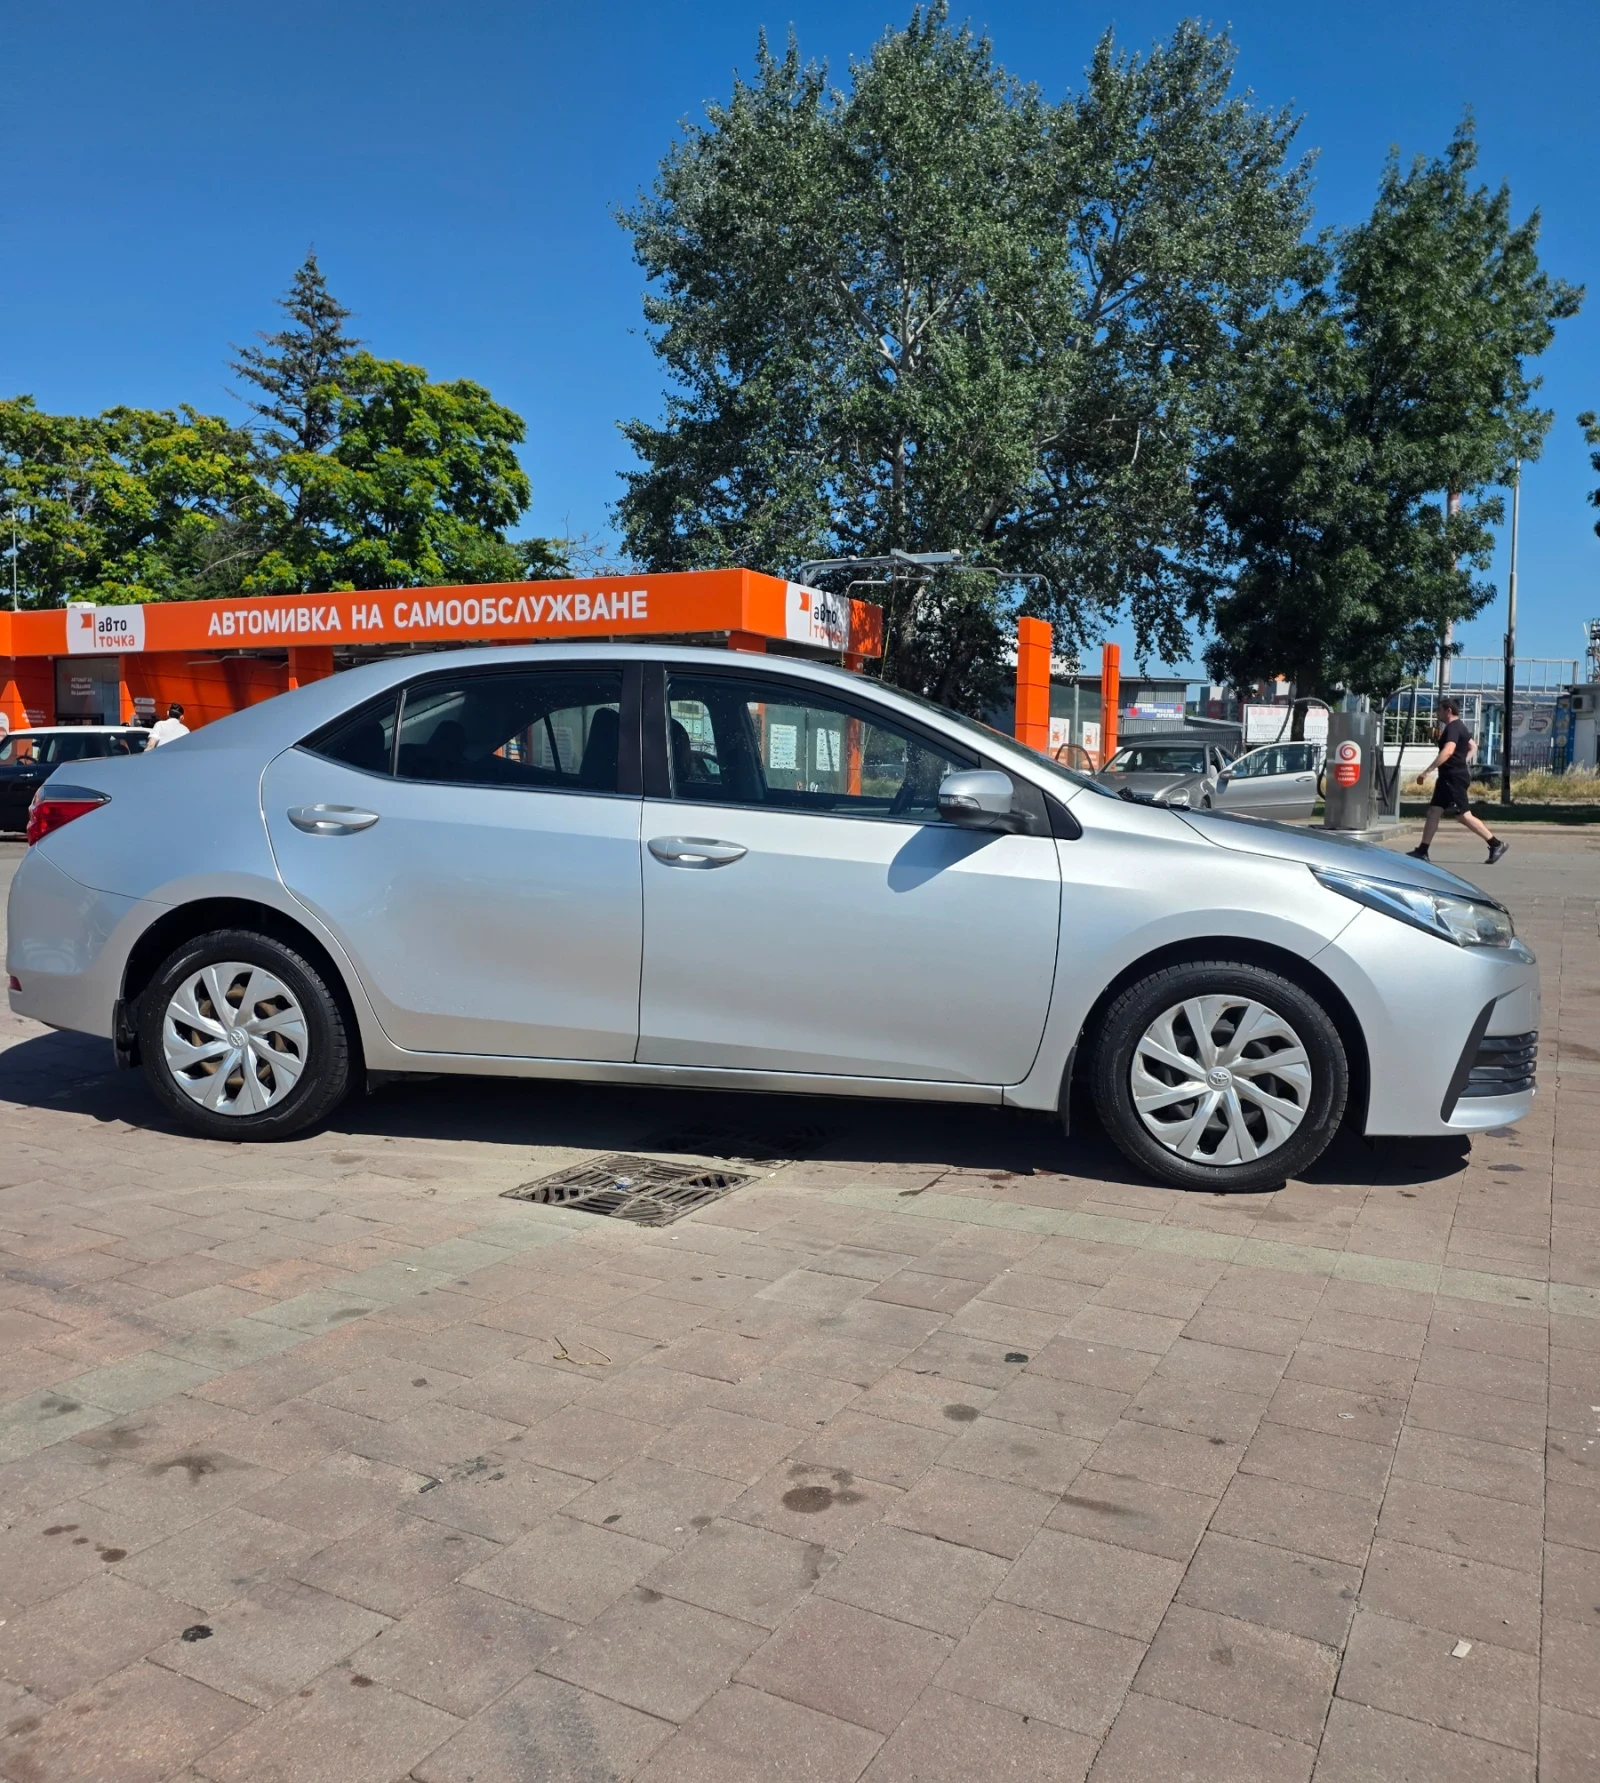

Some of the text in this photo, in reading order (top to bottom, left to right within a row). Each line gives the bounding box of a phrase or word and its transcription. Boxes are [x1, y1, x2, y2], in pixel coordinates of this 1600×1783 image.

[208, 590, 648, 636] АВТОМИВКА НА САМООБСЛУЖВАНЕ
[98, 616, 127, 633] авто
[98, 634, 135, 648] точка
